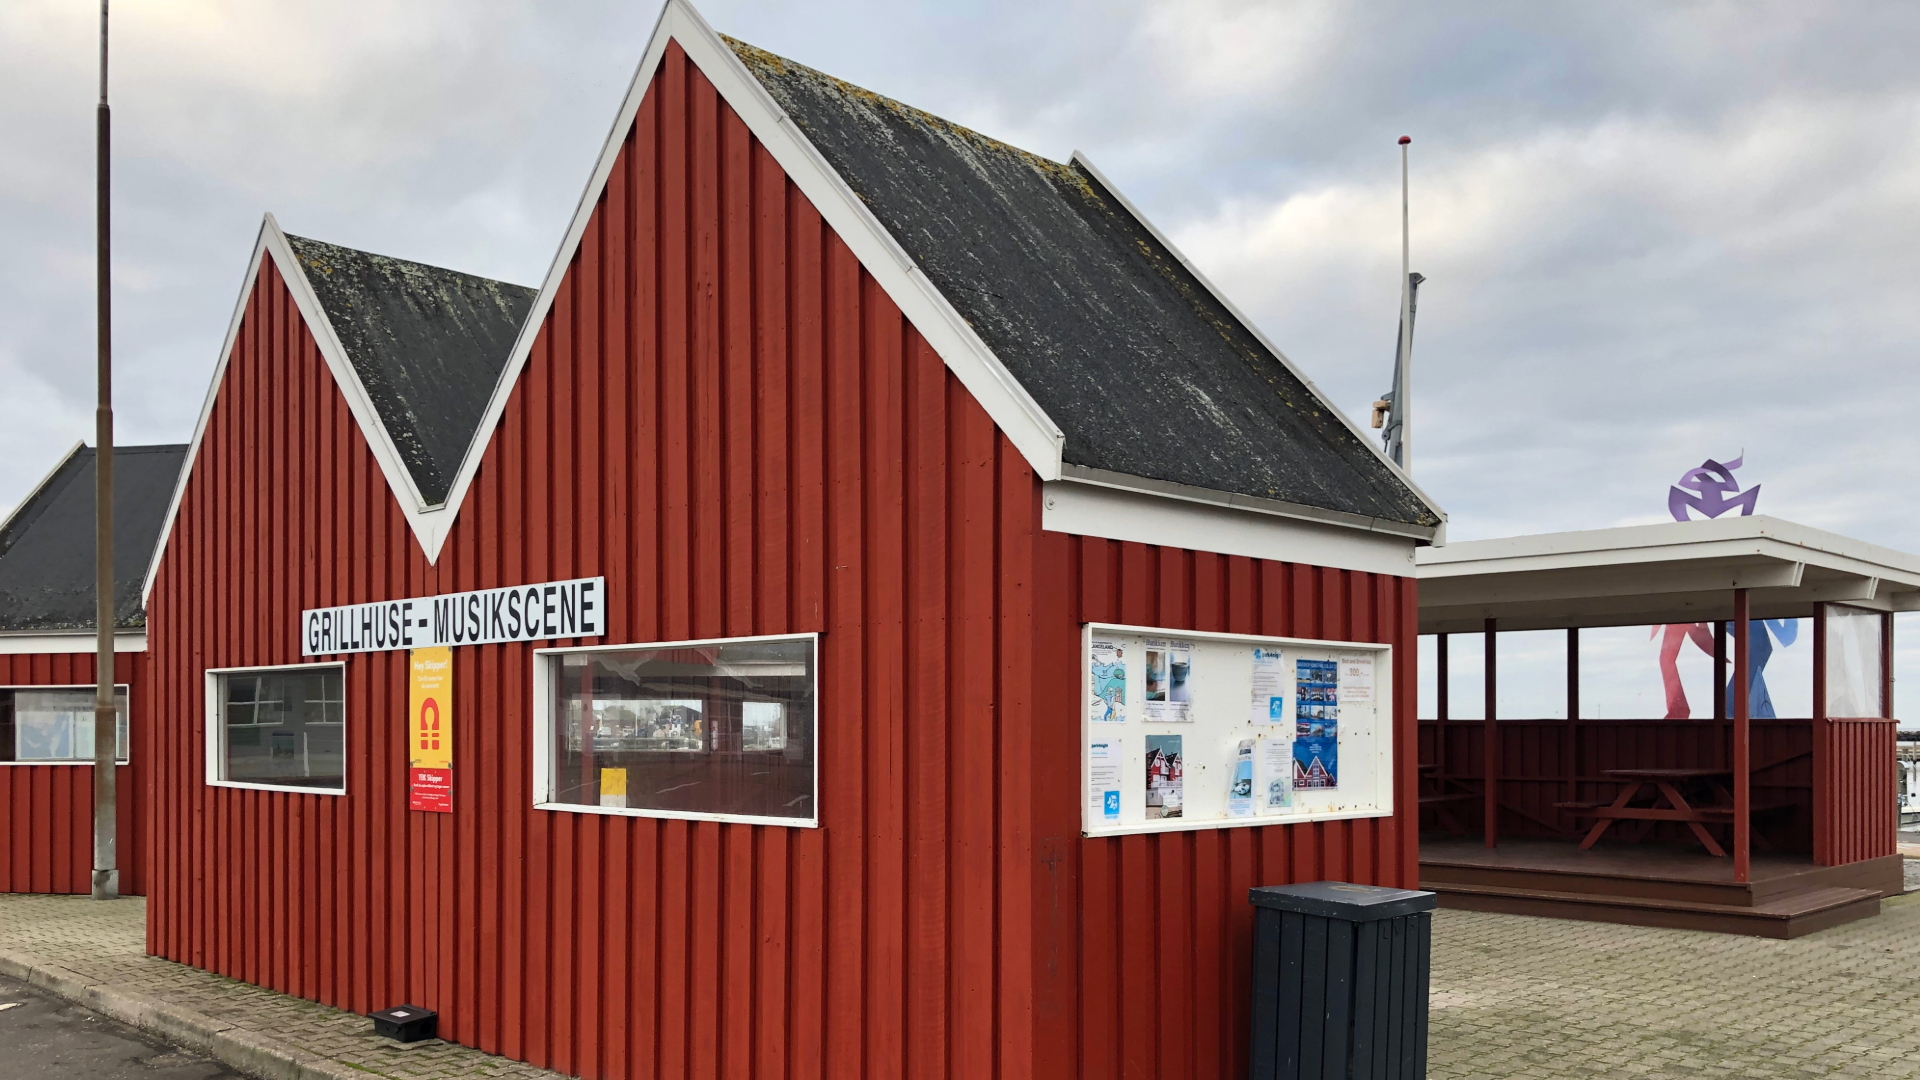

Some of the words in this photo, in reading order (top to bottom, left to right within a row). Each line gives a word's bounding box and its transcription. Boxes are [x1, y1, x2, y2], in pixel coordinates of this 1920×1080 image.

[308, 602, 413, 653] GRILLHUSE
[433, 581, 595, 644] MUSIKSCENE
[413, 660, 424, 673] Hey
[425, 659, 448, 673] Skipper!
